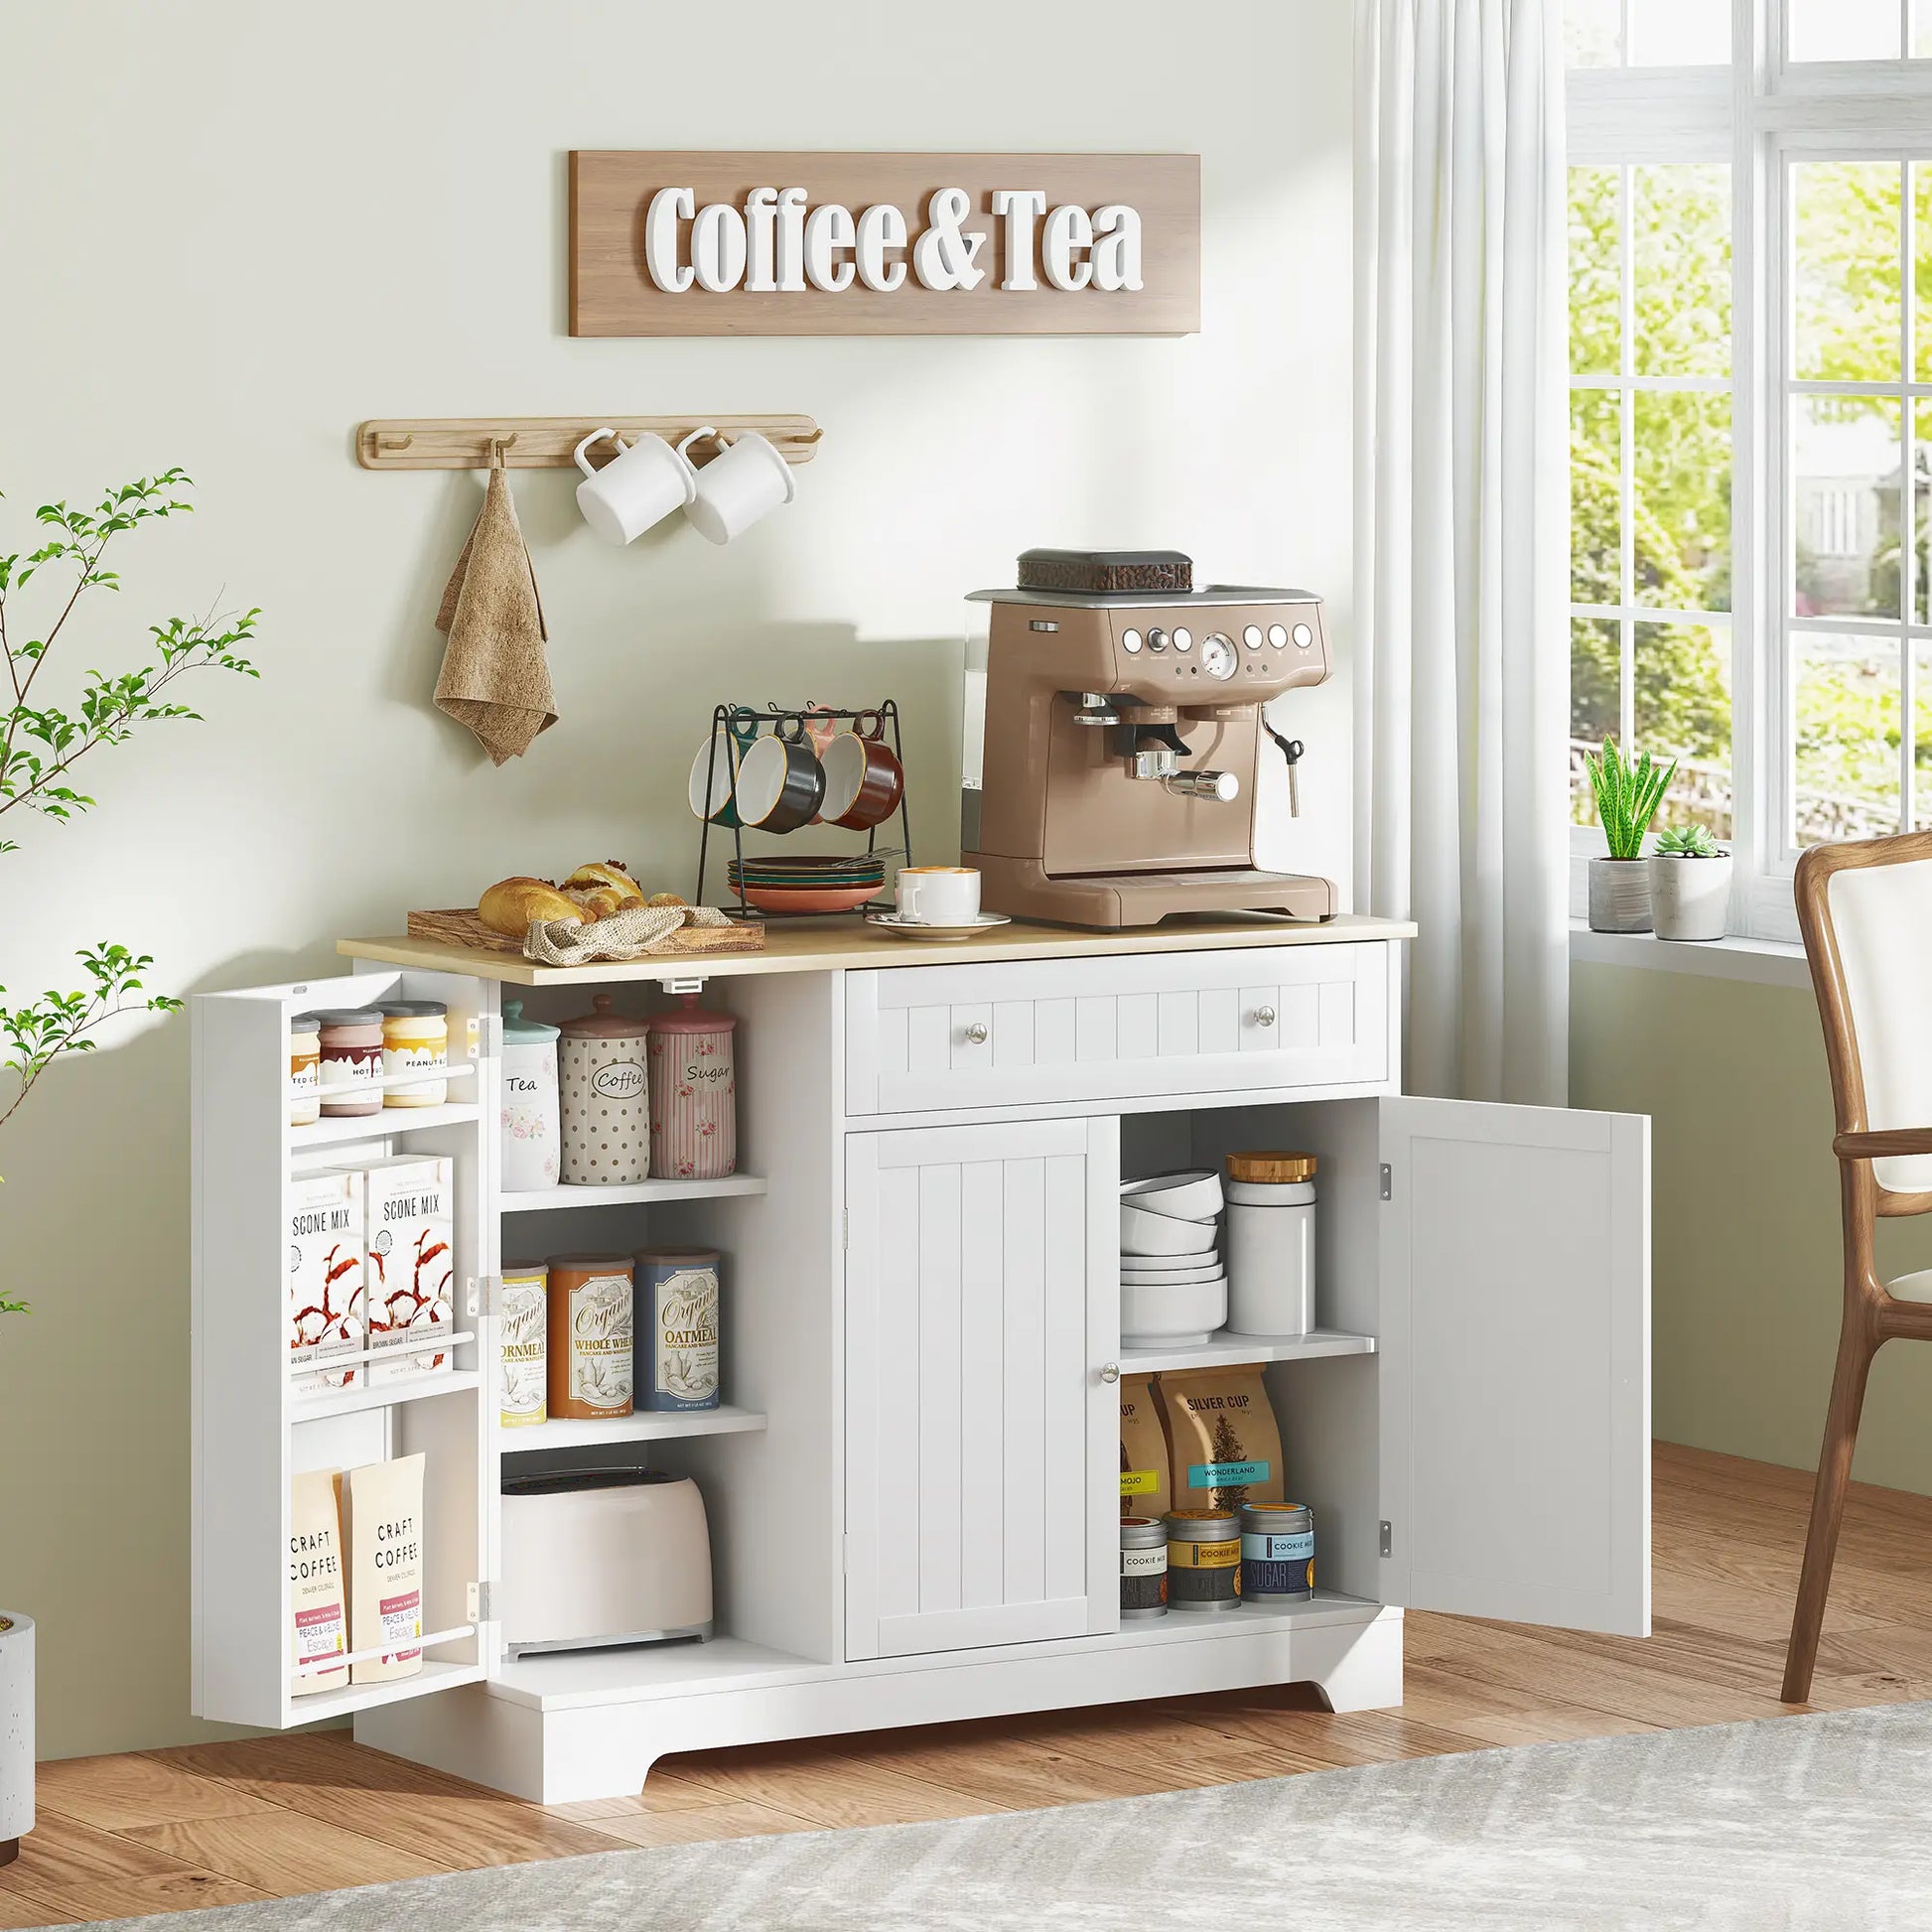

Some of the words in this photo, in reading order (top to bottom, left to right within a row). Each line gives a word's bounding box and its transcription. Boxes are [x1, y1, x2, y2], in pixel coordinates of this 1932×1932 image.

[645, 186, 908, 293] Coffee
[913, 187, 987, 291] &
[992, 189, 1144, 292] Tea
[405, 1058, 438, 1067] PEANUT
[597, 1071, 643, 1090] Coffee
[686, 1065, 732, 1082] Sugar
[505, 1077, 538, 1092] Tea
[383, 1197, 417, 1221] SCONE
[421, 1194, 440, 1215] MIX
[292, 1211, 327, 1236] SCONE
[331, 1208, 349, 1230] MIX
[664, 1328, 717, 1343] OATMEAL
[575, 1339, 611, 1350] WHOLE
[1120, 1404, 1136, 1417] UP
[1186, 1396, 1224, 1411] SILVER
[1226, 1395, 1250, 1409] CUP
[1203, 1466, 1255, 1477] WONDERLAND
[378, 1518, 412, 1541] CRAFT
[291, 1531, 329, 1554] CRAFT
[1274, 1541, 1304, 1550] COOKIE
[375, 1542, 417, 1569] COFFEE
[1126, 1556, 1156, 1566] COOKIE
[1200, 1549, 1230, 1558] COOKIE
[1251, 1562, 1287, 1587] SUGAR
